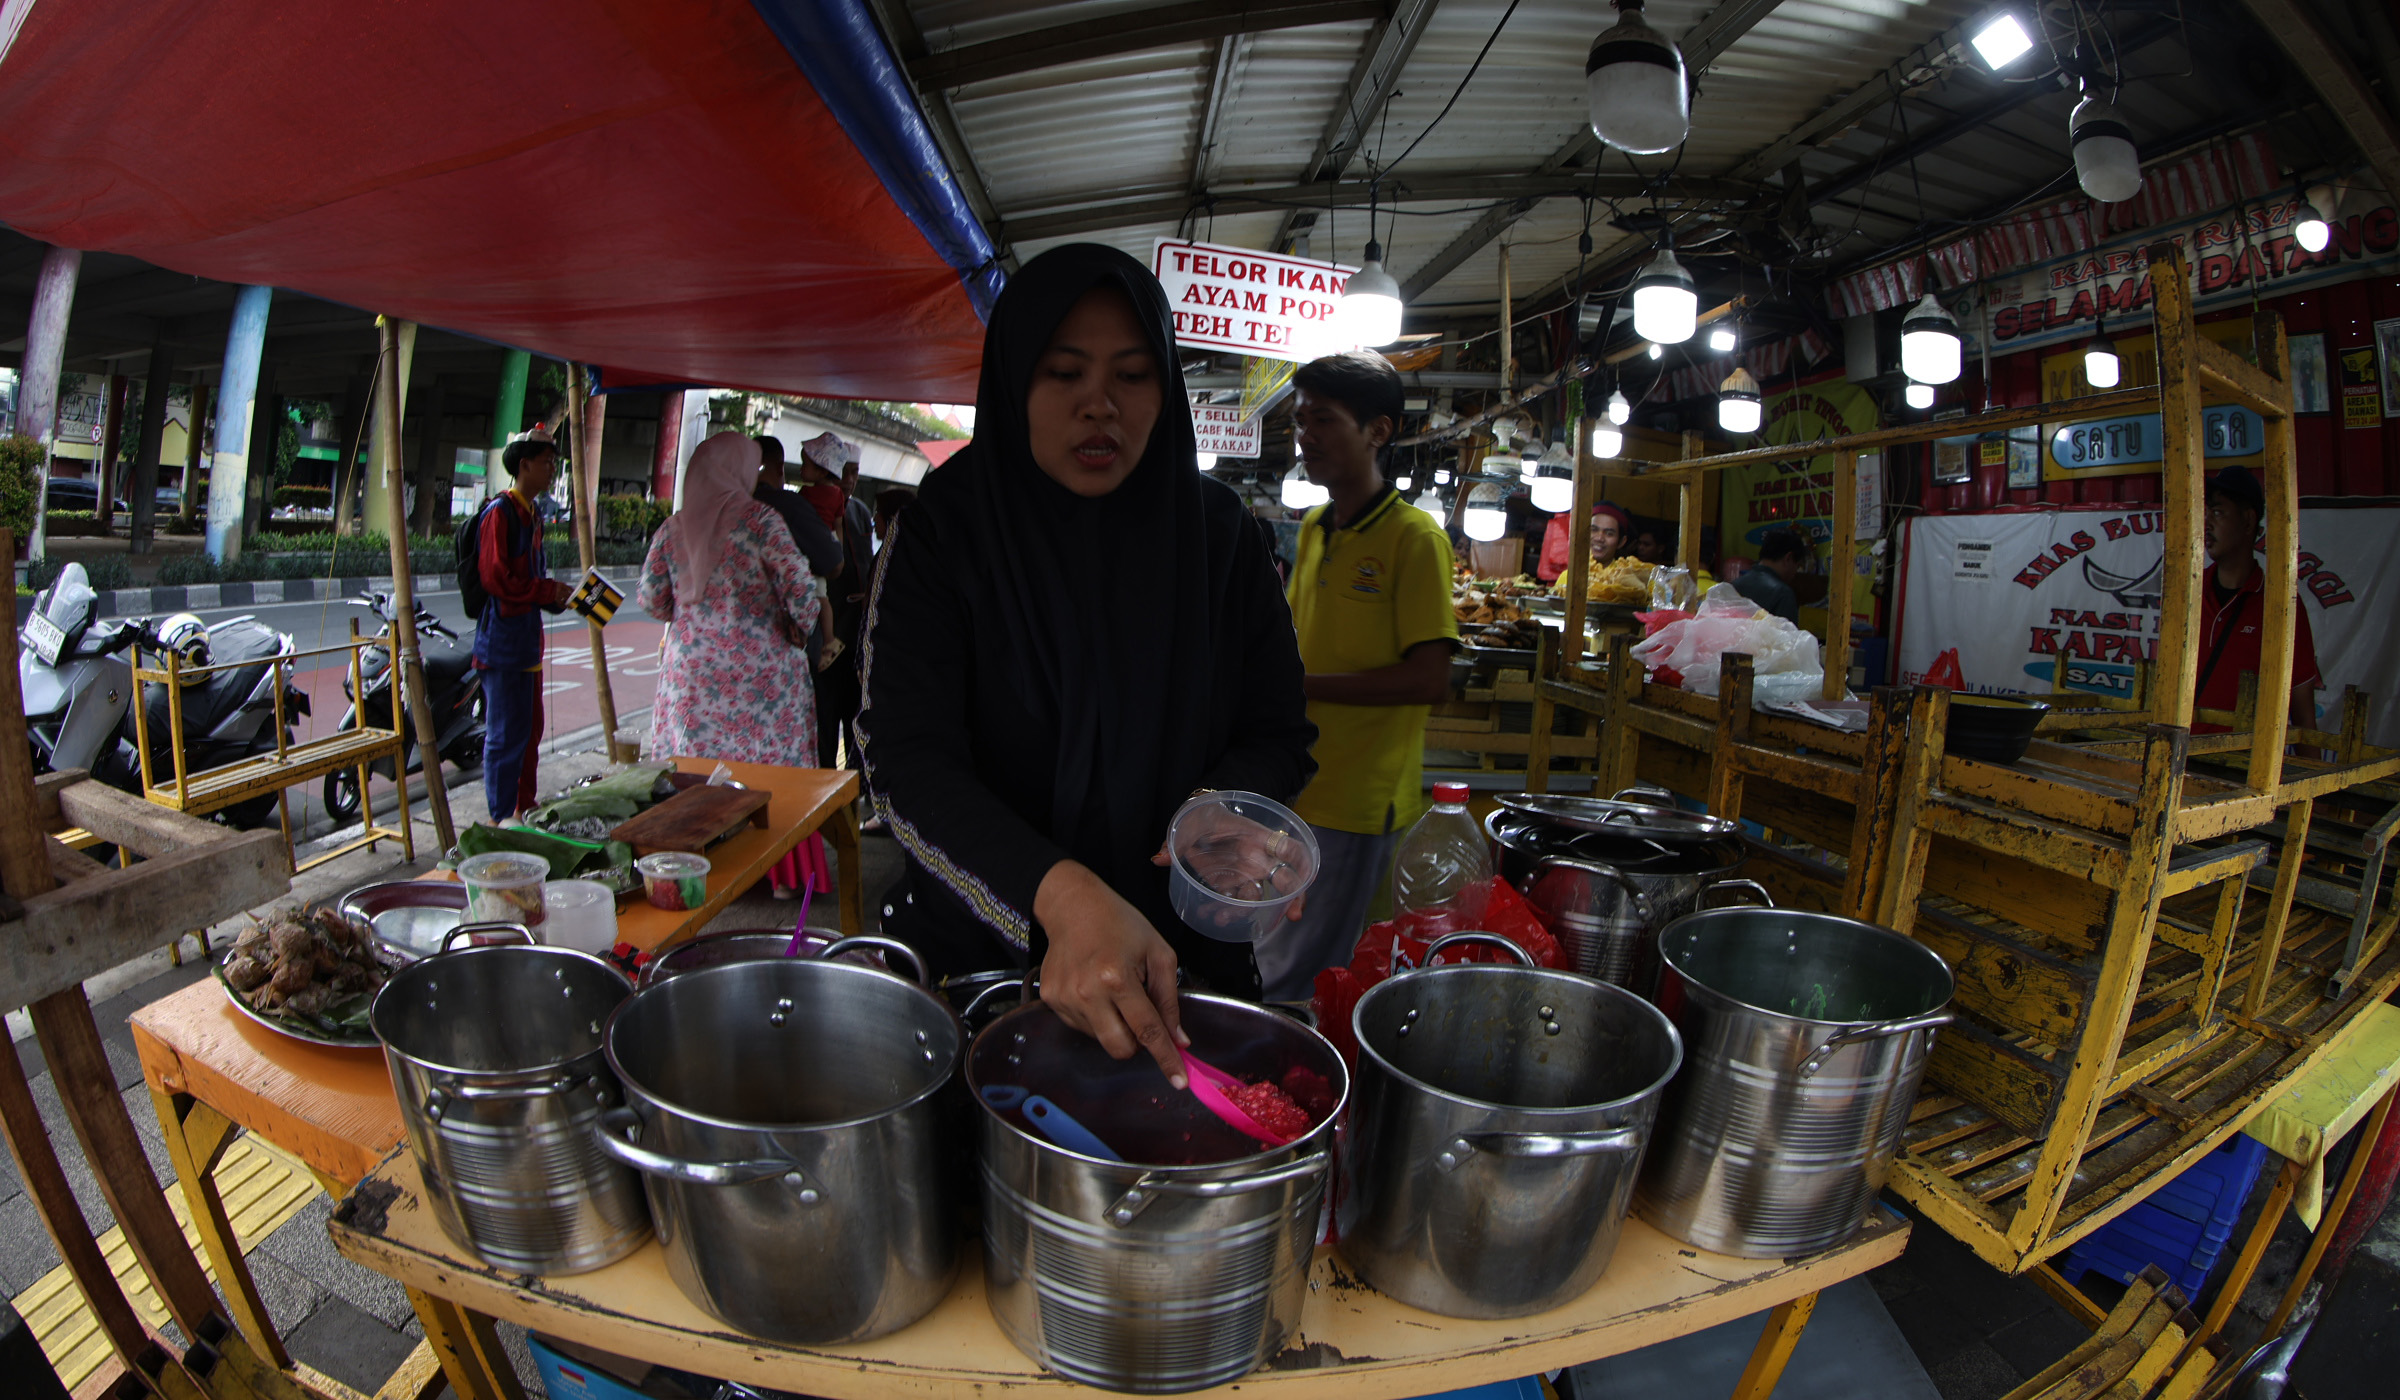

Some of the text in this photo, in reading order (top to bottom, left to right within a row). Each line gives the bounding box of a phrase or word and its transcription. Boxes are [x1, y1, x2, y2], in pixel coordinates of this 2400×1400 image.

[1173, 252, 1348, 295] TELOR IKAN
[2051, 233, 2185, 290] KAPA
[1182, 283, 1335, 321] AYAM POP
[1994, 261, 2193, 340] SELAM
[1172, 311, 1233, 338] TEH
[1197, 425, 1254, 437] CABE HIJAU
[1212, 440, 1252, 452] KAKAP
[2072, 412, 2247, 462] SATU GA
[2013, 530, 2096, 590] KHAS
[2101, 512, 2164, 541] BU
[2051, 608, 2142, 631] NASI
[2067, 668, 2134, 690] SAT
